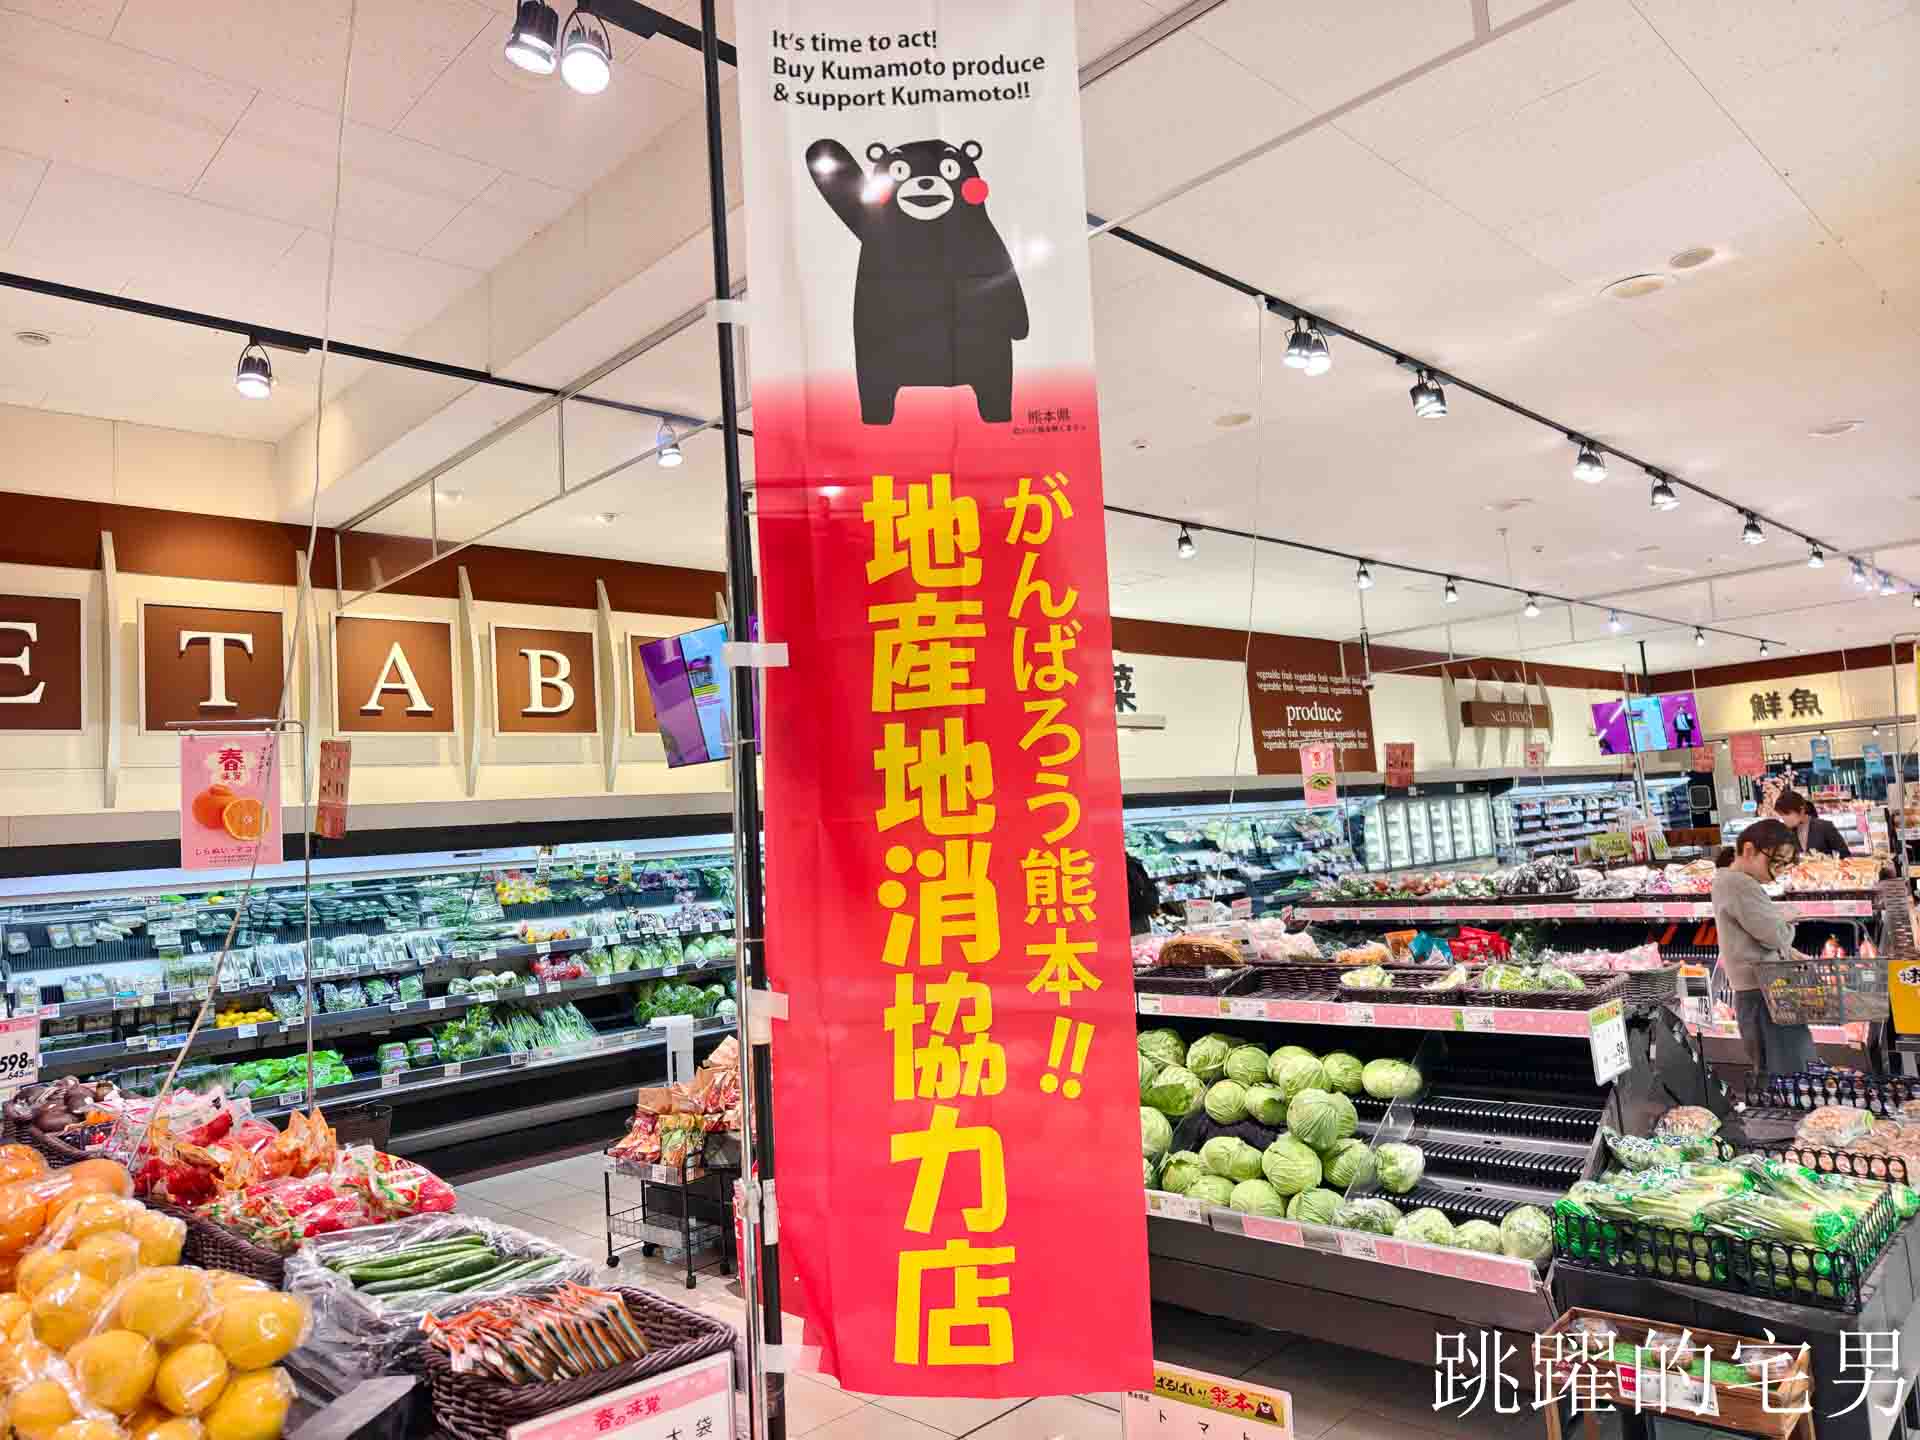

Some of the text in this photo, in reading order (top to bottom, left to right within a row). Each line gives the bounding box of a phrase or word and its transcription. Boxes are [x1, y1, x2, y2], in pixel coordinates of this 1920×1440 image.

[772, 29, 937, 53] It's time to act!
[772, 55, 1046, 83] Buy Kumamoto produce
[773, 82, 1031, 112] & support Kumamoto!!
[1286, 701, 1343, 726] produce
[1750, 687, 1823, 722] 鮮魚
[862, 472, 1017, 1367] 地産地消協力店
[594, 1395, 662, 1431] 春の味覚
